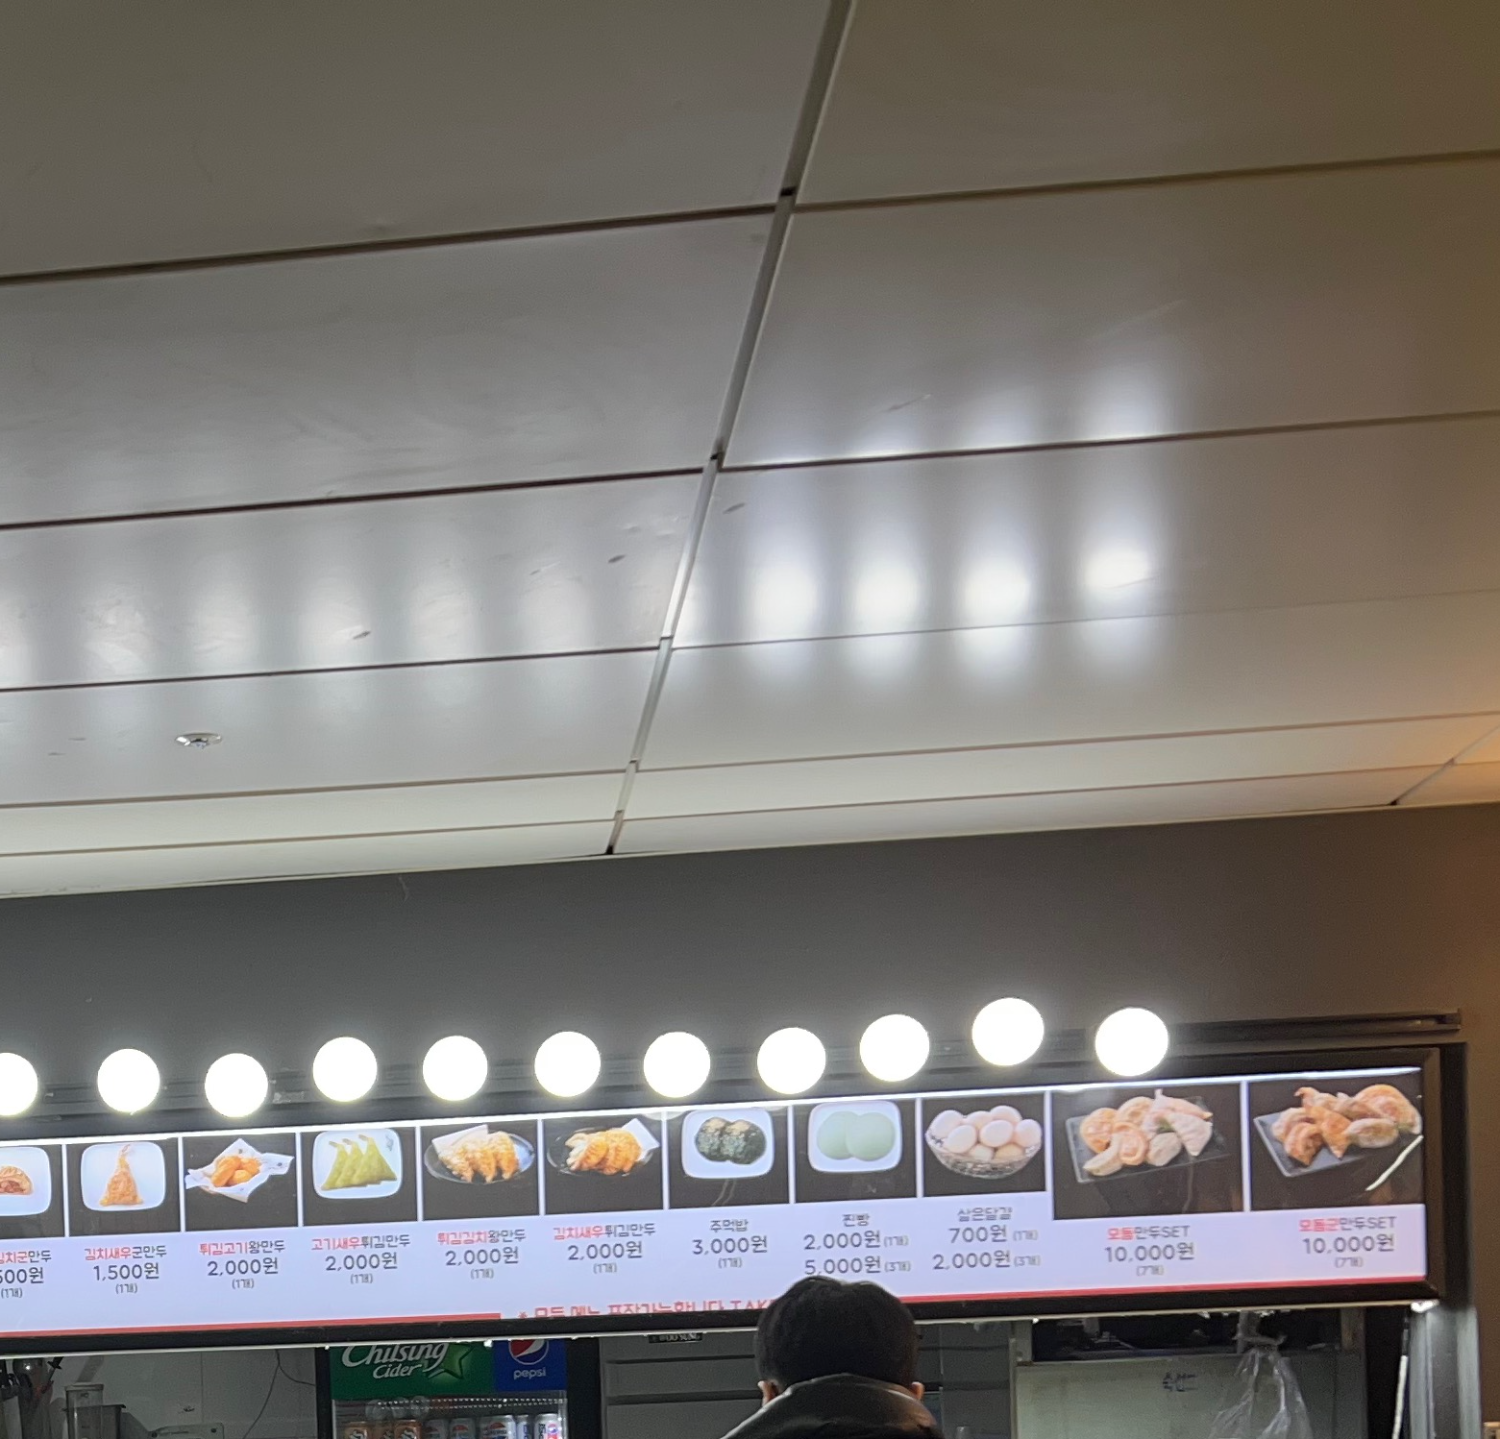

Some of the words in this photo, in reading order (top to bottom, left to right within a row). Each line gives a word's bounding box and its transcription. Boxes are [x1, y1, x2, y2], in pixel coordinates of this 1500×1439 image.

[842, 1213, 870, 1228] 찐빵
[957, 1207, 1012, 1222] 삶은달걀
[553, 1223, 656, 1241] 김치새우튀김만두
[709, 1219, 749, 1233] 주먹밥
[949, 1224, 1007, 1244] 700원
[311, 1234, 411, 1252] 고기새우튀김만두
[437, 1229, 526, 1246] 튀김김치왕만두
[692, 1235, 768, 1256] 3,000원
[804, 1230, 881, 1252] 2,000원
[1302, 1234, 1396, 1255] 10,000원
[85, 1245, 167, 1261] 김치새우군만두
[199, 1240, 286, 1256] 튀김고기왕만두
[445, 1246, 519, 1267] 2,000원
[568, 1241, 643, 1261] 2,000원
[1104, 1242, 1195, 1264] 10,000원
[207, 1257, 279, 1277] 2,000원
[325, 1251, 398, 1272] 2,000원
[804, 1255, 881, 1277] 5,000원
[932, 1249, 1011, 1271] 2,000원
[93, 1262, 160, 1281] 1,500원
[373, 1364, 422, 1379] Cider
[514, 1367, 546, 1380] pepsi
